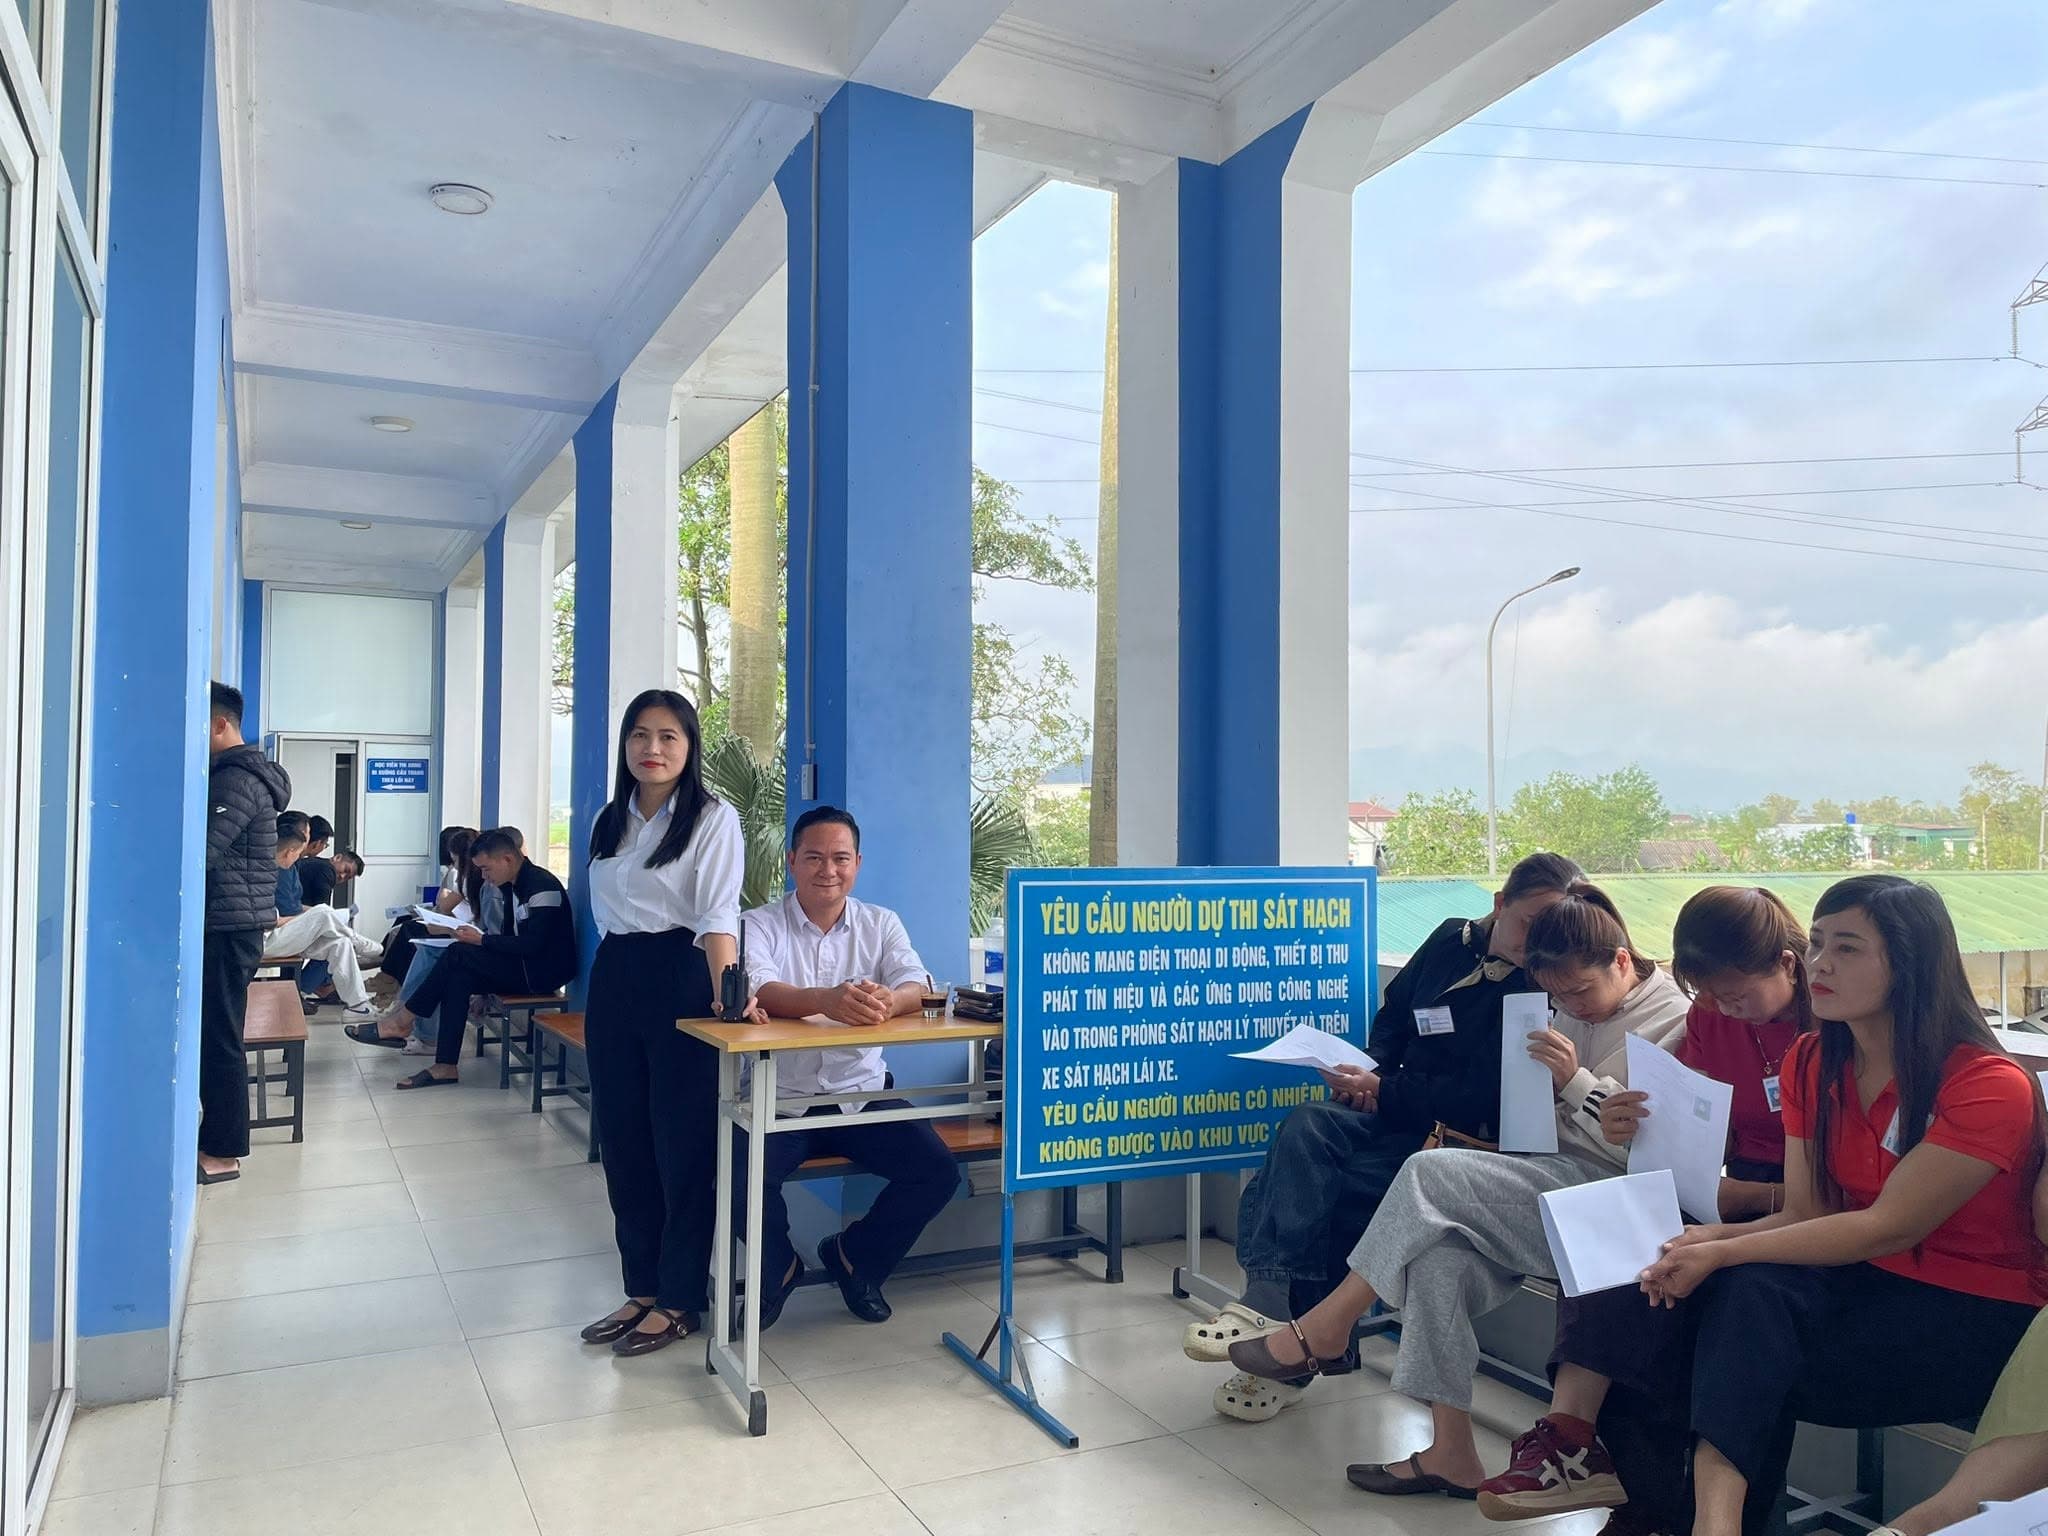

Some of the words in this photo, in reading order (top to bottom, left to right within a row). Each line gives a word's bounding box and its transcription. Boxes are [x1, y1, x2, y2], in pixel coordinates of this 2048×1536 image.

[1041, 896, 1079, 935] YÊU
[1086, 890, 1126, 934] CẦU
[1132, 893, 1192, 932] NGƯỜI
[1198, 897, 1225, 938] DỰ
[1229, 899, 1257, 930] THI
[1264, 892, 1298, 929] SÁT
[1303, 898, 1350, 935] HẠCH
[1043, 947, 1090, 974] KHÔNG
[1095, 951, 1134, 973] MANG
[1139, 944, 1169, 975] ĐIỆN
[1174, 948, 1210, 973] THOẠI
[1215, 947, 1228, 968] DI
[1232, 942, 1270, 971] ĐỘNG,
[1274, 939, 1306, 966] THIẾT
[1310, 944, 1322, 969] BỊ
[1326, 944, 1349, 964] THU
[1043, 985, 1078, 1012] PHÁT
[1085, 984, 1106, 1010] TÍN
[1114, 983, 1143, 1014] HIỆU
[1150, 981, 1167, 1008] VÀ
[1173, 980, 1199, 1006] CÁC
[1206, 979, 1232, 1005] ỨNG
[1238, 980, 1272, 1007] DỤNG
[1278, 976, 1311, 1001] CÔNG
[1317, 974, 1349, 1003] NGHỆ
[1042, 1024, 1069, 1051] VÀO
[1073, 1026, 1118, 1049] TRONG
[1122, 1018, 1166, 1047] PHÒNG
[1170, 1017, 1195, 1043] SÁT
[1198, 1018, 1232, 1046] HẠCH
[1236, 1014, 1249, 1040] LÝ
[1319, 1010, 1349, 1034] TRÊN
[1042, 1067, 1060, 1090] XE
[1064, 1061, 1090, 1088] SÁT
[1094, 1062, 1130, 1091] HẠCH
[1134, 1056, 1154, 1083] LÁI
[1158, 1059, 1178, 1082] XE.
[1042, 1100, 1077, 1127] YÊU
[1083, 1094, 1118, 1123] CẦU
[1124, 1092, 1177, 1120] NGƯỜI
[1183, 1089, 1240, 1115] KHÔNG
[1246, 1085, 1267, 1110] CÓ
[1040, 1136, 1102, 1163] KHÔNG
[1107, 1131, 1155, 1159] ĐƯỢC
[1160, 1127, 1194, 1152] VÀO
[1199, 1125, 1232, 1148] KHU
[1238, 1122, 1269, 1148] VỰC
